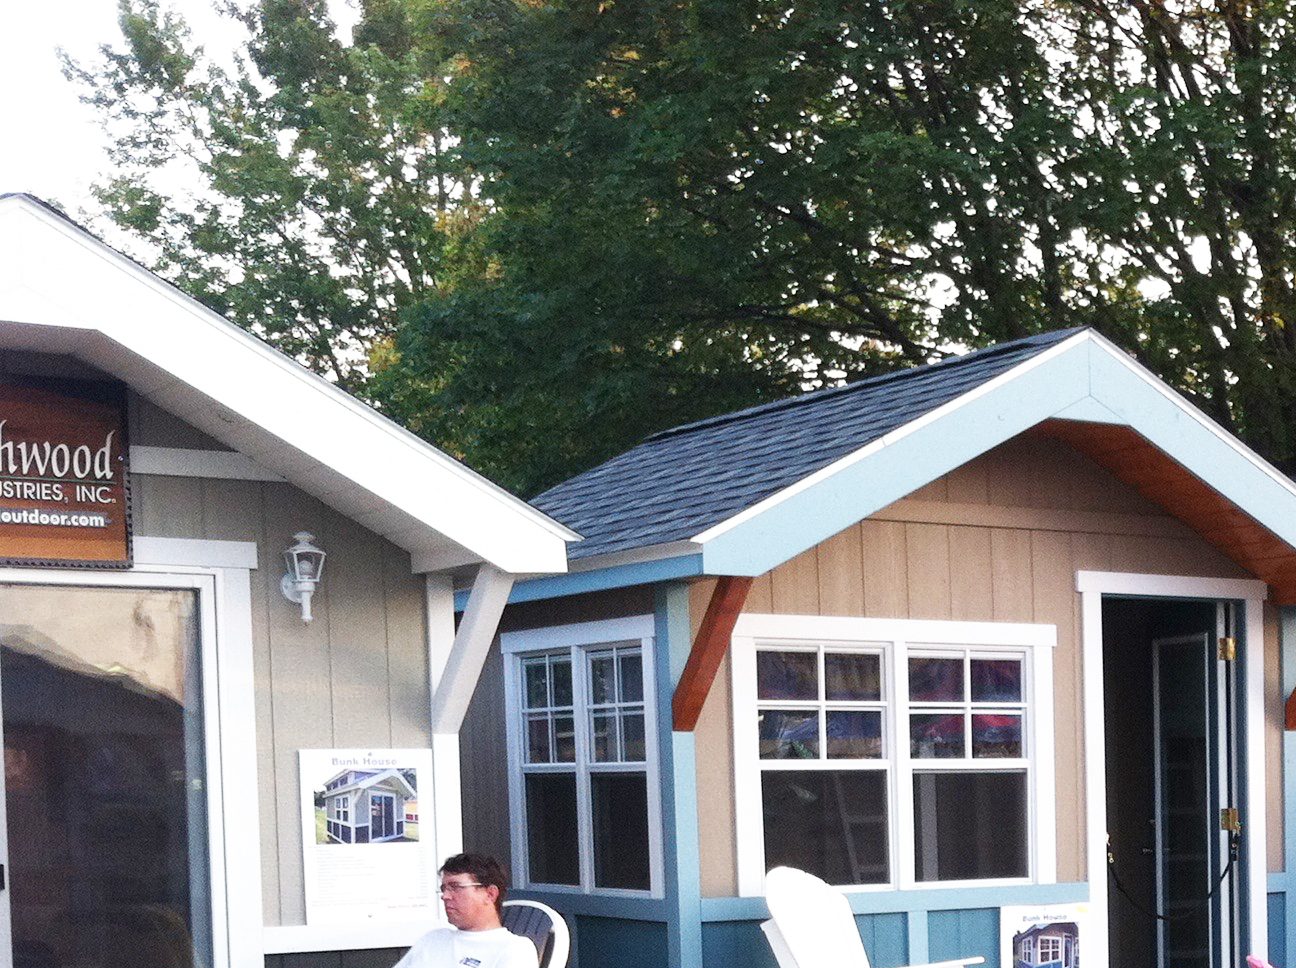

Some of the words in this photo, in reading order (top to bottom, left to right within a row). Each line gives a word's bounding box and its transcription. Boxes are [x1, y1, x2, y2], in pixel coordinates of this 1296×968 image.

[76, 485, 116, 503] INC.
[331, 757, 358, 766] Bunk
[362, 757, 398, 766] House
